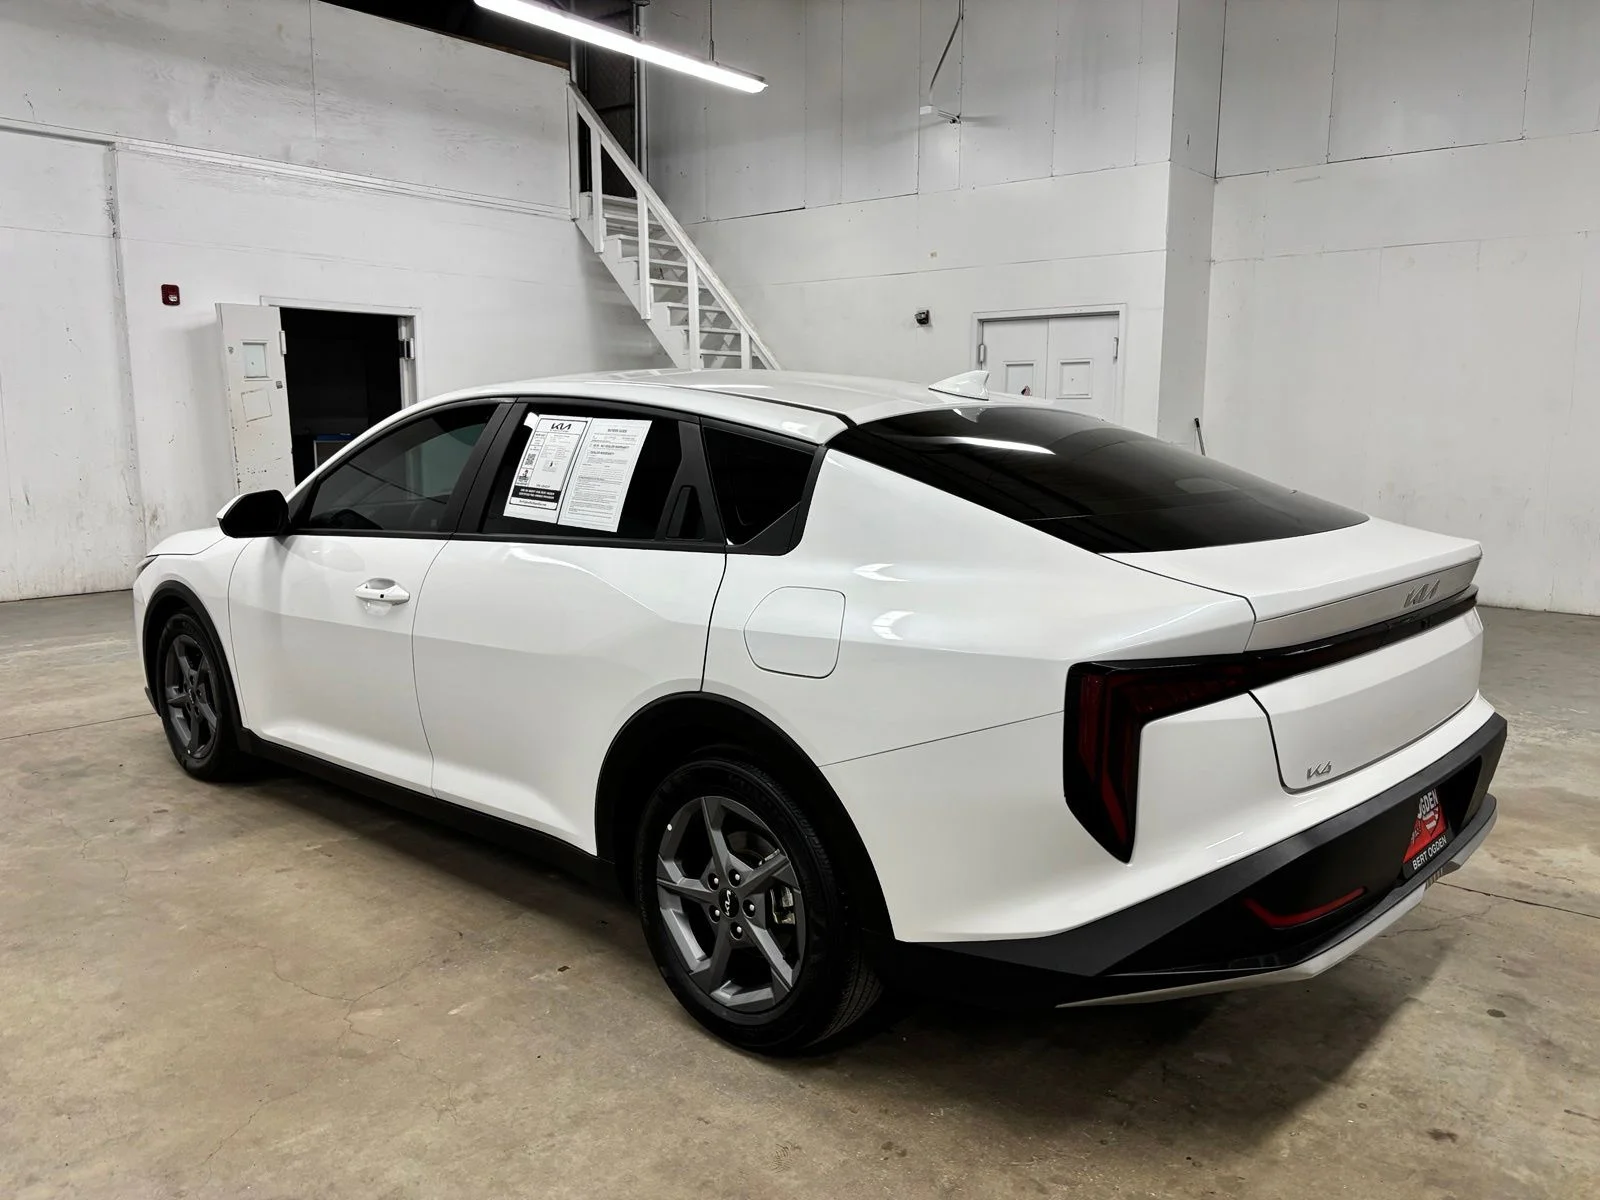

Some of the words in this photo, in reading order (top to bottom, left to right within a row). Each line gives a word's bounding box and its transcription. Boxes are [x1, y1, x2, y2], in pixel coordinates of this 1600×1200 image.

[1403, 579, 1440, 608] KIA
[1412, 850, 1428, 870] BERT
[1427, 834, 1447, 857] OGDEN
